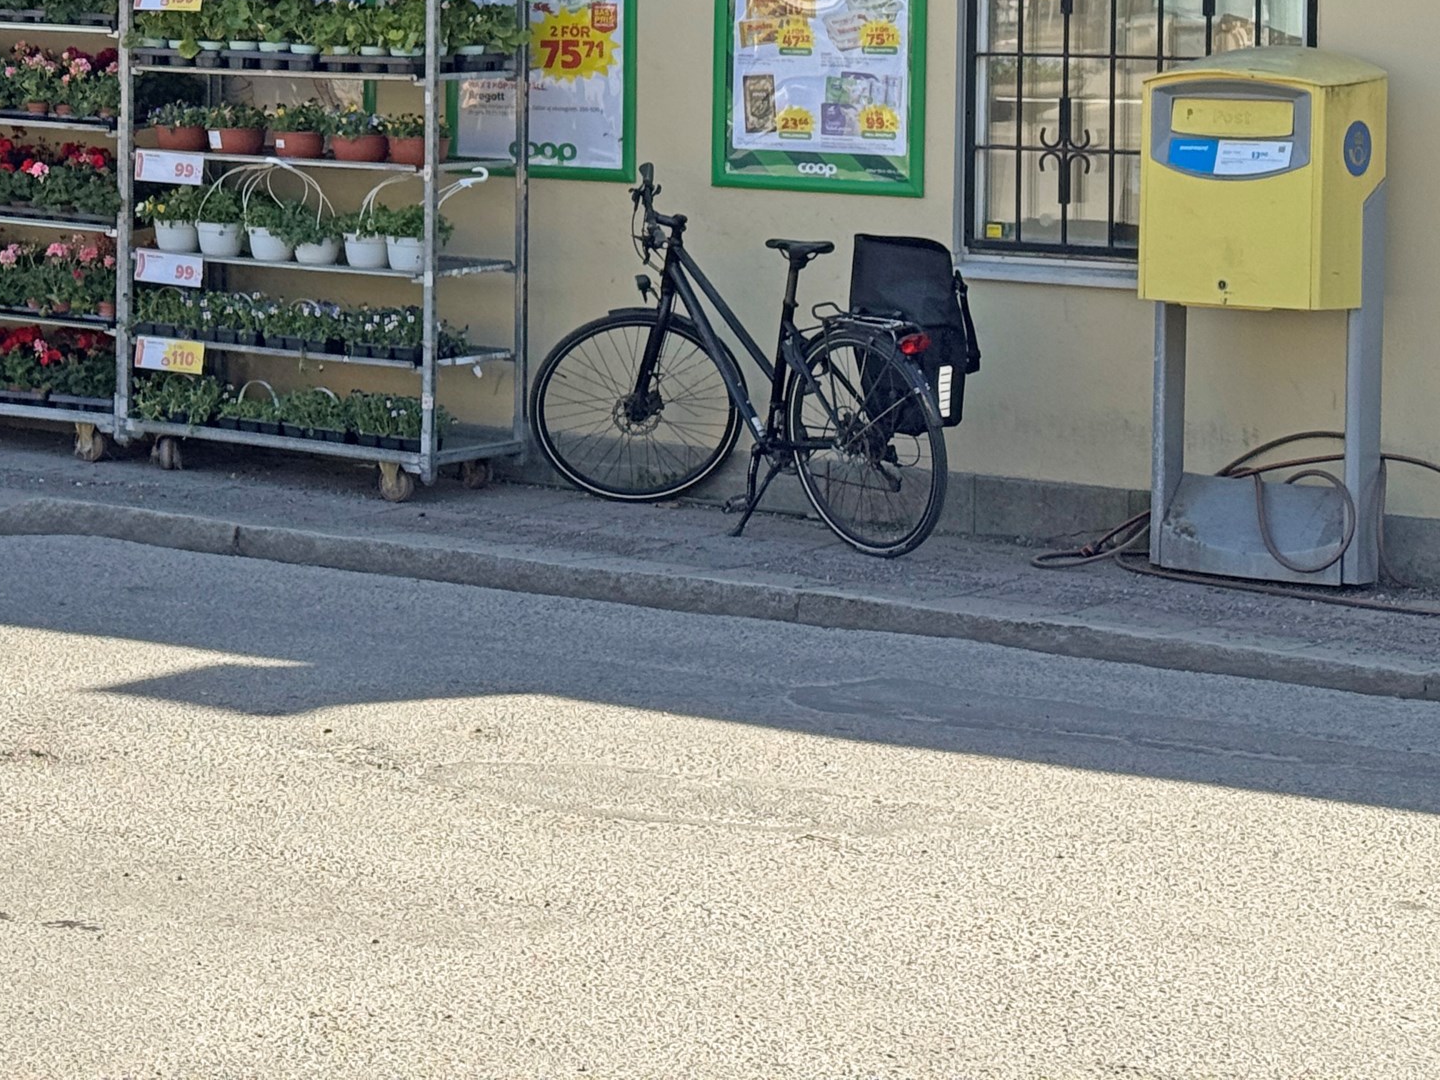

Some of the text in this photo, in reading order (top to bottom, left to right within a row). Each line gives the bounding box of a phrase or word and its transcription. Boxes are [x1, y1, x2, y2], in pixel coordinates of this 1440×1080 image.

[550, 25, 590, 38] 2 FÖR
[797, 162, 837, 177] coop
